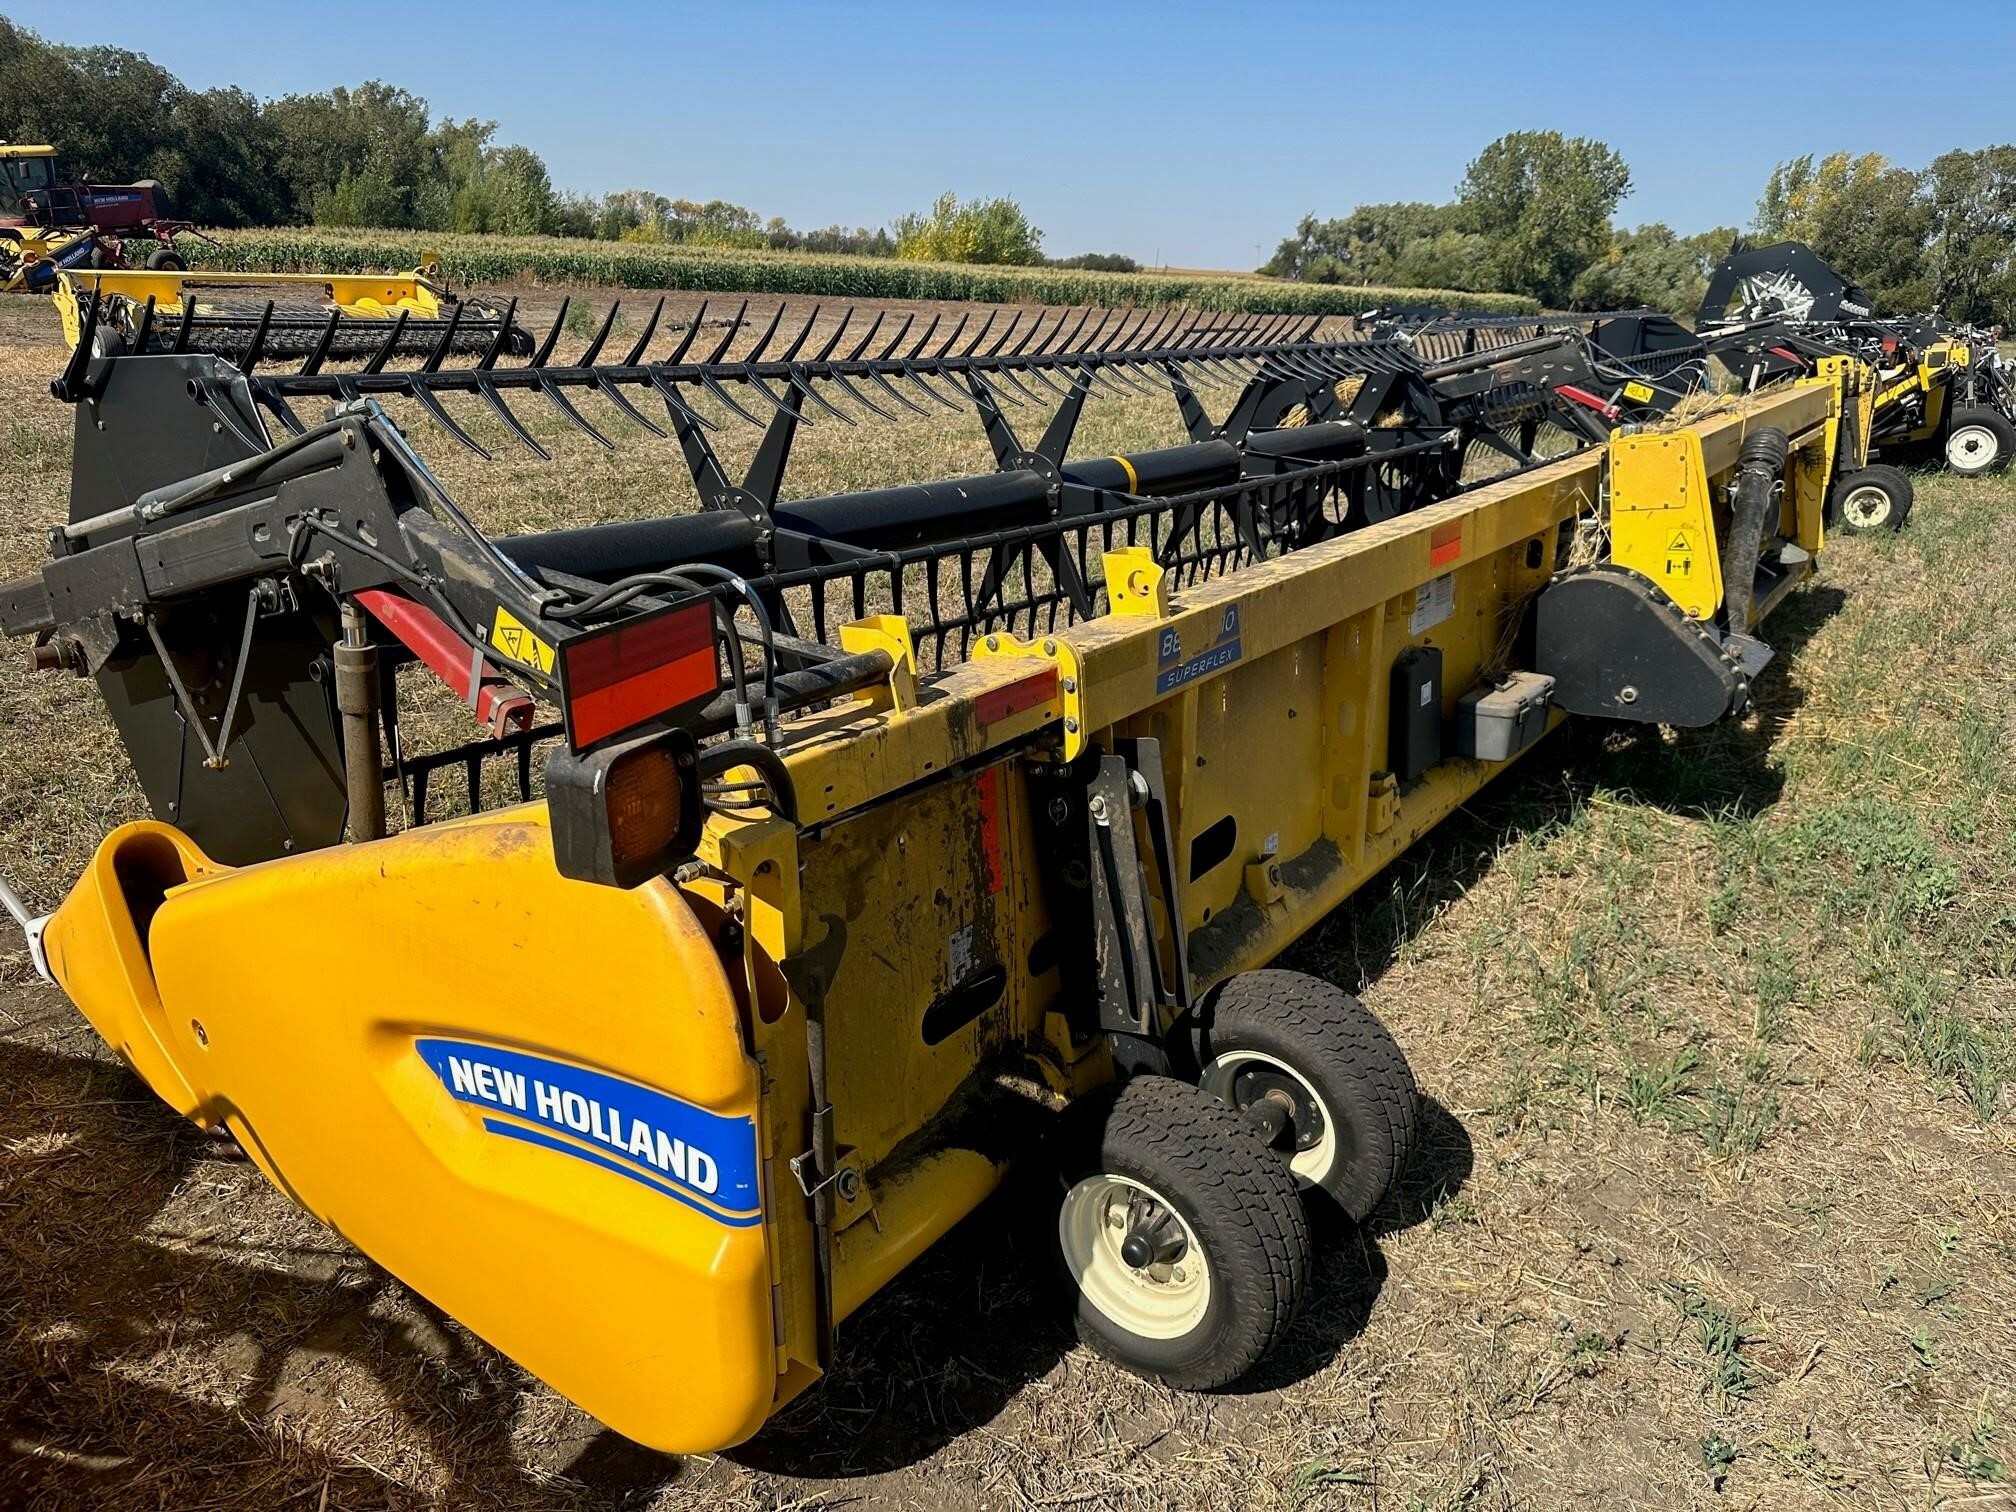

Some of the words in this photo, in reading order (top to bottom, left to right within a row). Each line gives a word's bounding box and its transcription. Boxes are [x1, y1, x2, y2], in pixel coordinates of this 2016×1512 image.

[63, 247, 85, 265] HOLLAND
[1166, 647, 1234, 688] SUPERFLEX
[447, 1055, 528, 1113] NEW
[533, 1079, 720, 1196] HOLLAND
